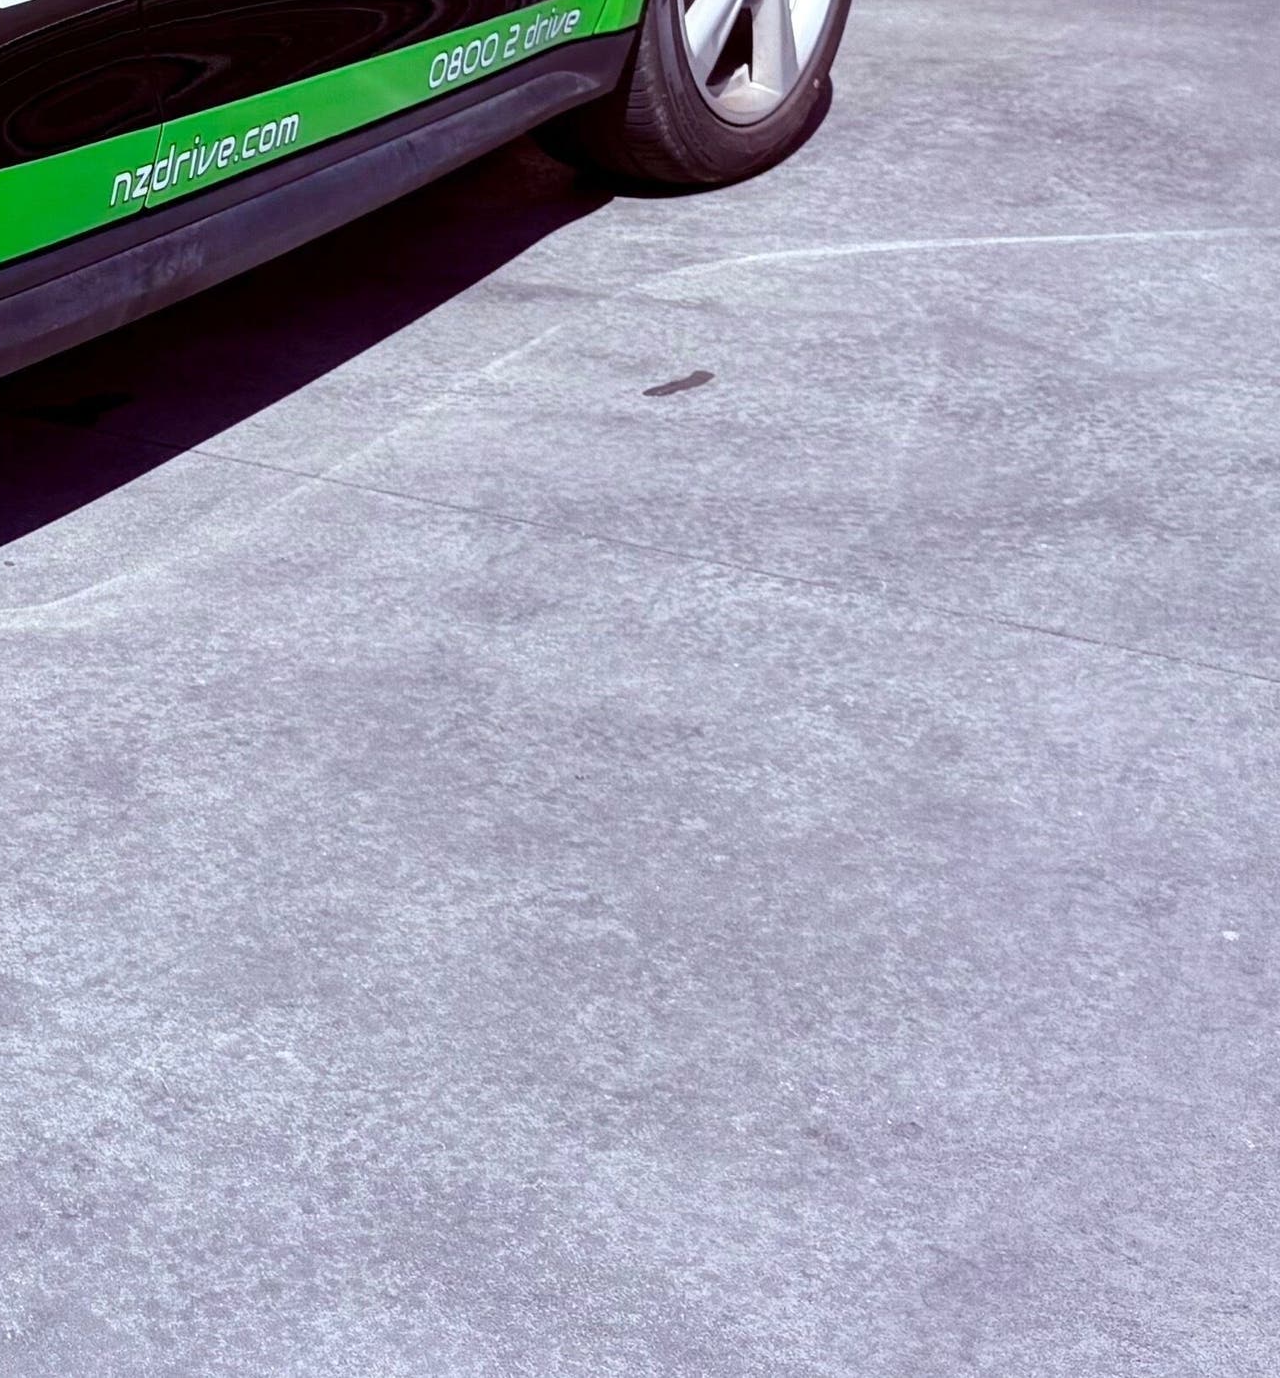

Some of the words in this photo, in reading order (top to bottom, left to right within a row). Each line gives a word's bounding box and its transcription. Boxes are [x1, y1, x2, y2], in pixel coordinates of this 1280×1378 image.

[428, 32, 499, 88] 0800
[503, 24, 520, 59] 2
[524, 7, 580, 50] drive
[109, 113, 300, 207] nzdrive.com
